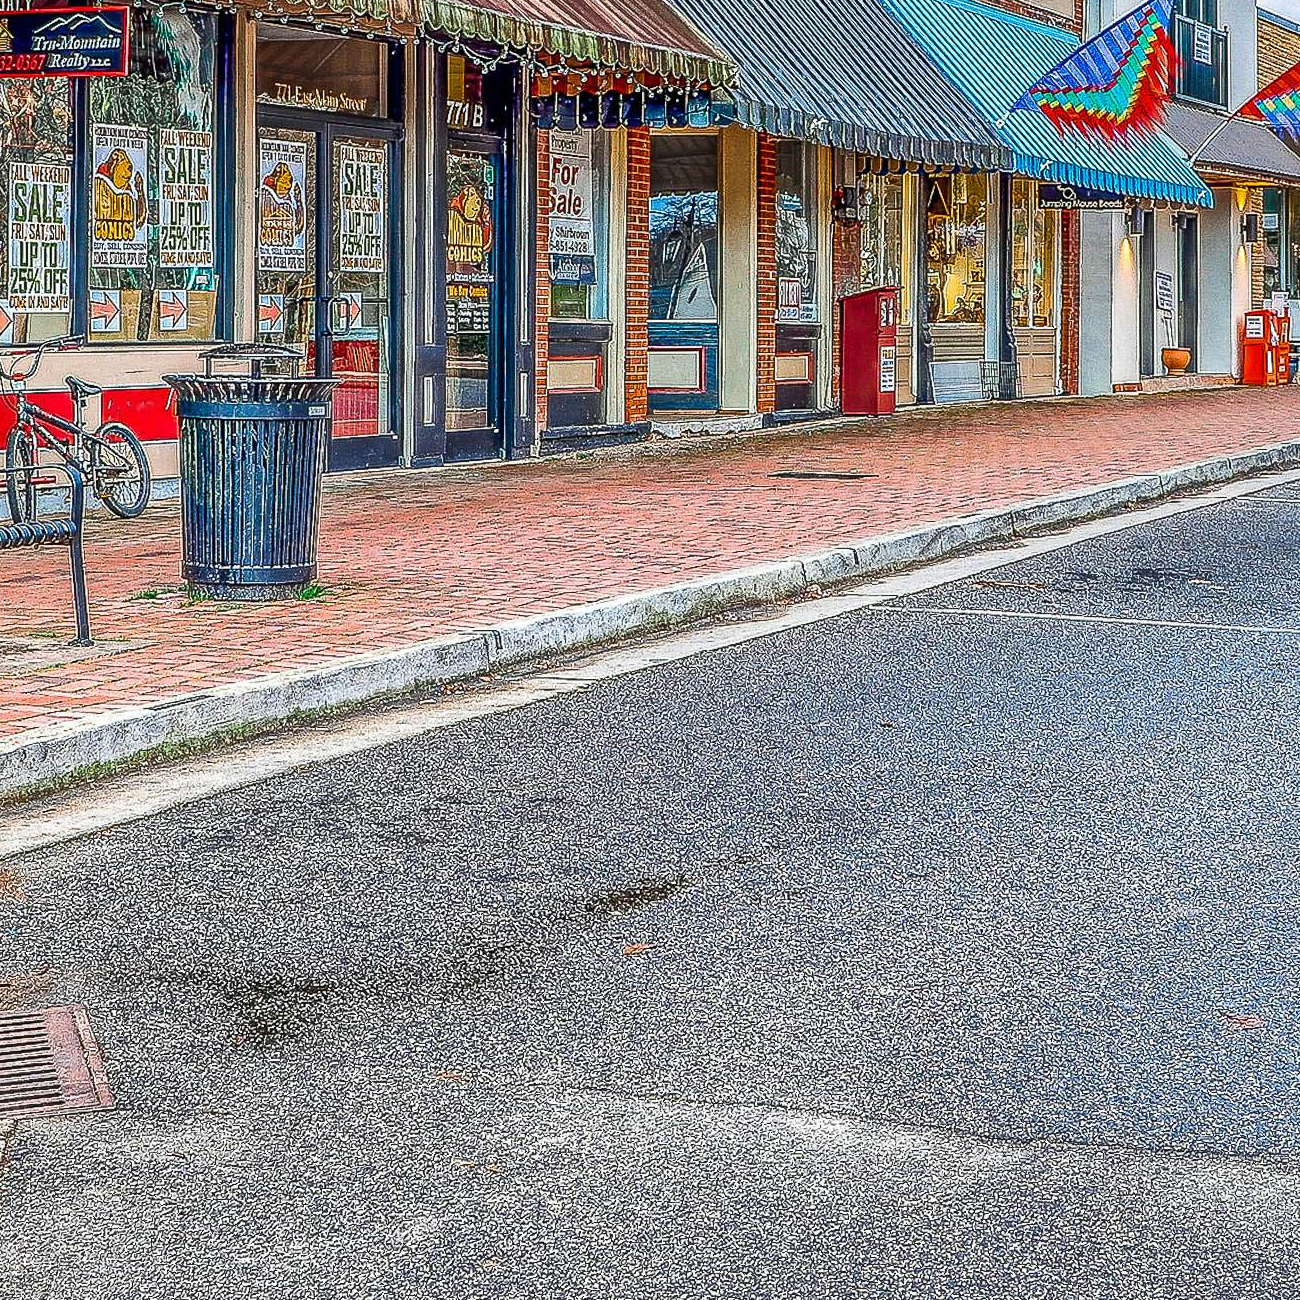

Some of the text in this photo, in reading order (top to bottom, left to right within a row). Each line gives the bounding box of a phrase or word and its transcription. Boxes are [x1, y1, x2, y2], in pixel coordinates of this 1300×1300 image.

[32, 34, 122, 52] Tru-Mountain
[50, 52, 91, 70] Realty
[339, 92, 368, 111] Street
[446, 100, 483, 127] 771 B
[161, 131, 176, 146] FALL
[11, 163, 70, 184] FALL WEEKEND
[164, 148, 207, 185] SALE
[552, 158, 580, 187] For
[343, 163, 380, 197] SALE
[14, 182, 65, 225] SALE
[170, 201, 202, 225] UP TO
[549, 187, 584, 216] Sale
[1040, 199, 1124, 209] Jumping Mouse Beads
[11, 223, 27, 241] FRI,
[50, 224, 66, 241] SUN
[94, 215, 132, 236] COMICS
[349, 212, 374, 235] UP TO
[161, 226, 210, 251] 25% OFF
[342, 234, 382, 257] 25% OFF
[19, 241, 58, 268] UP TO
[448, 246, 483, 262] COMICS
[10, 268, 68, 295] 25% OFF
